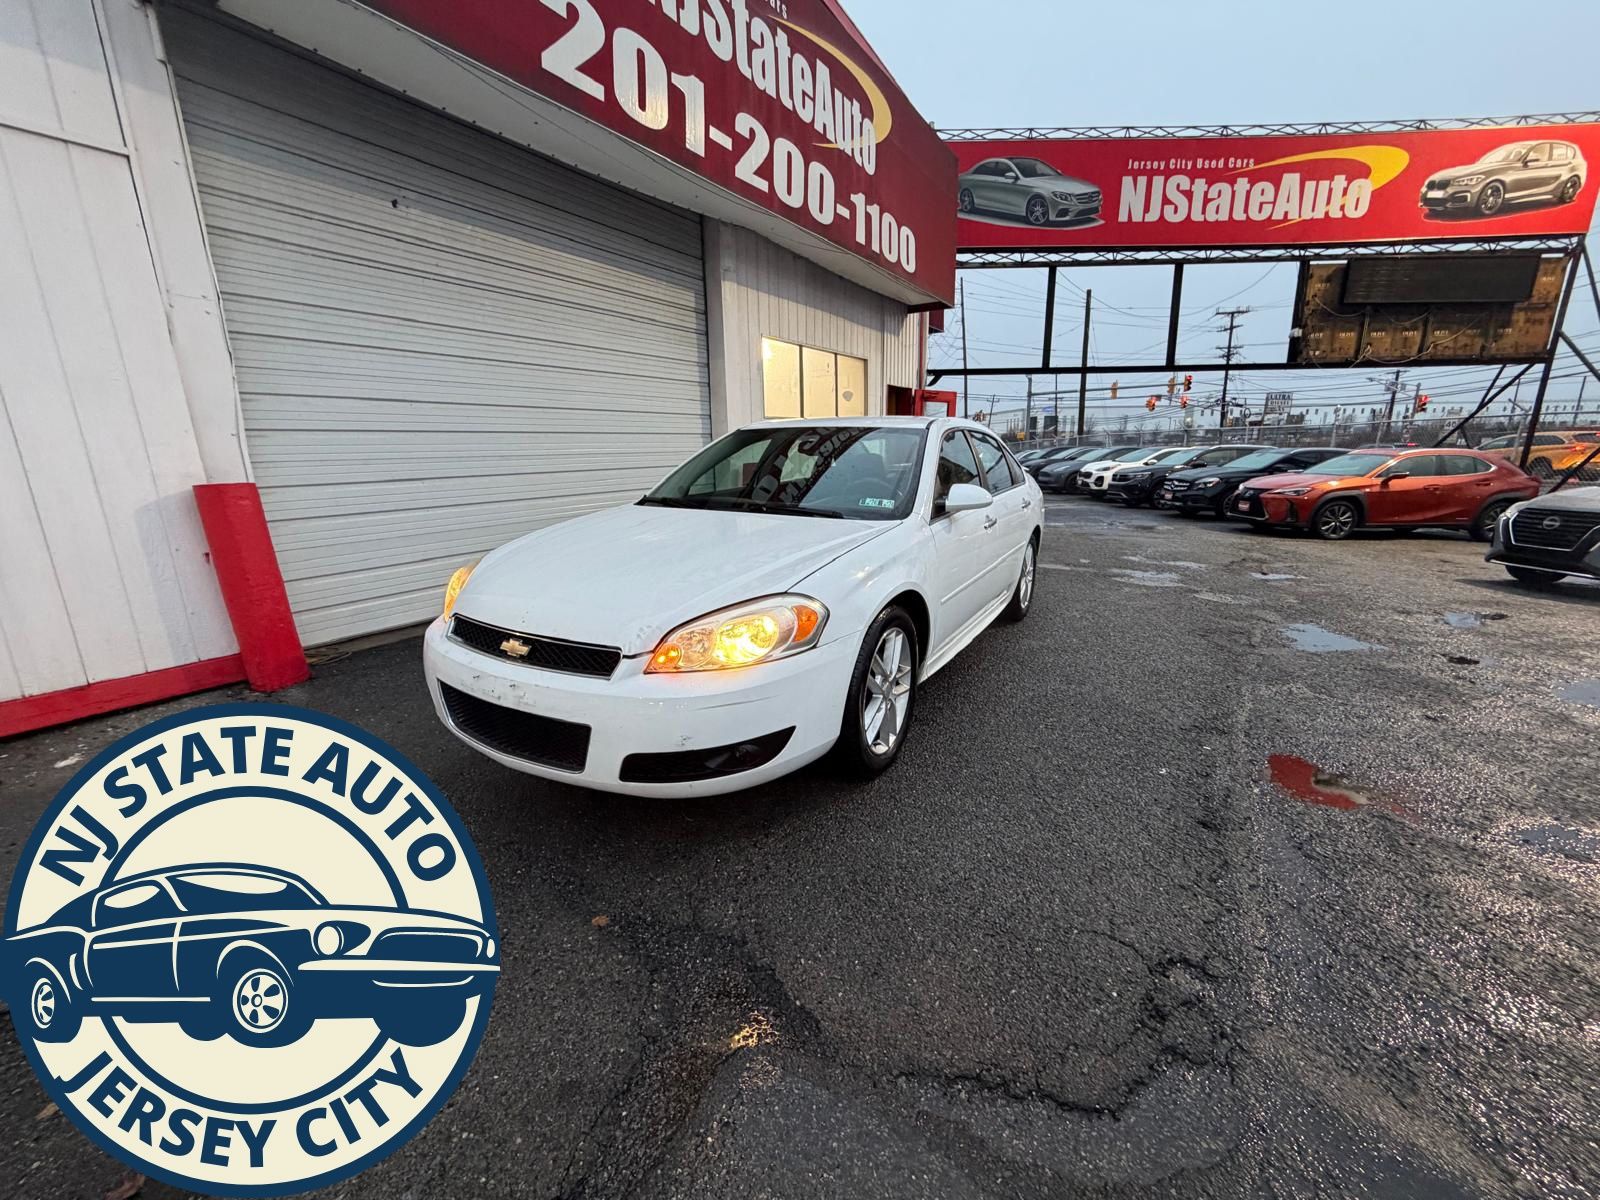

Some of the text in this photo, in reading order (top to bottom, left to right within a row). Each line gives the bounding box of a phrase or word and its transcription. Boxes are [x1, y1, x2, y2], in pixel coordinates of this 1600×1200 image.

[765, 0, 787, 19] ars
[648, 0, 877, 176] StateAuto
[538, 0, 917, 274] 201-200-1100
[1128, 156, 1255, 170] Jersey City Used Cars
[1118, 172, 1373, 224] NJStateAuto
